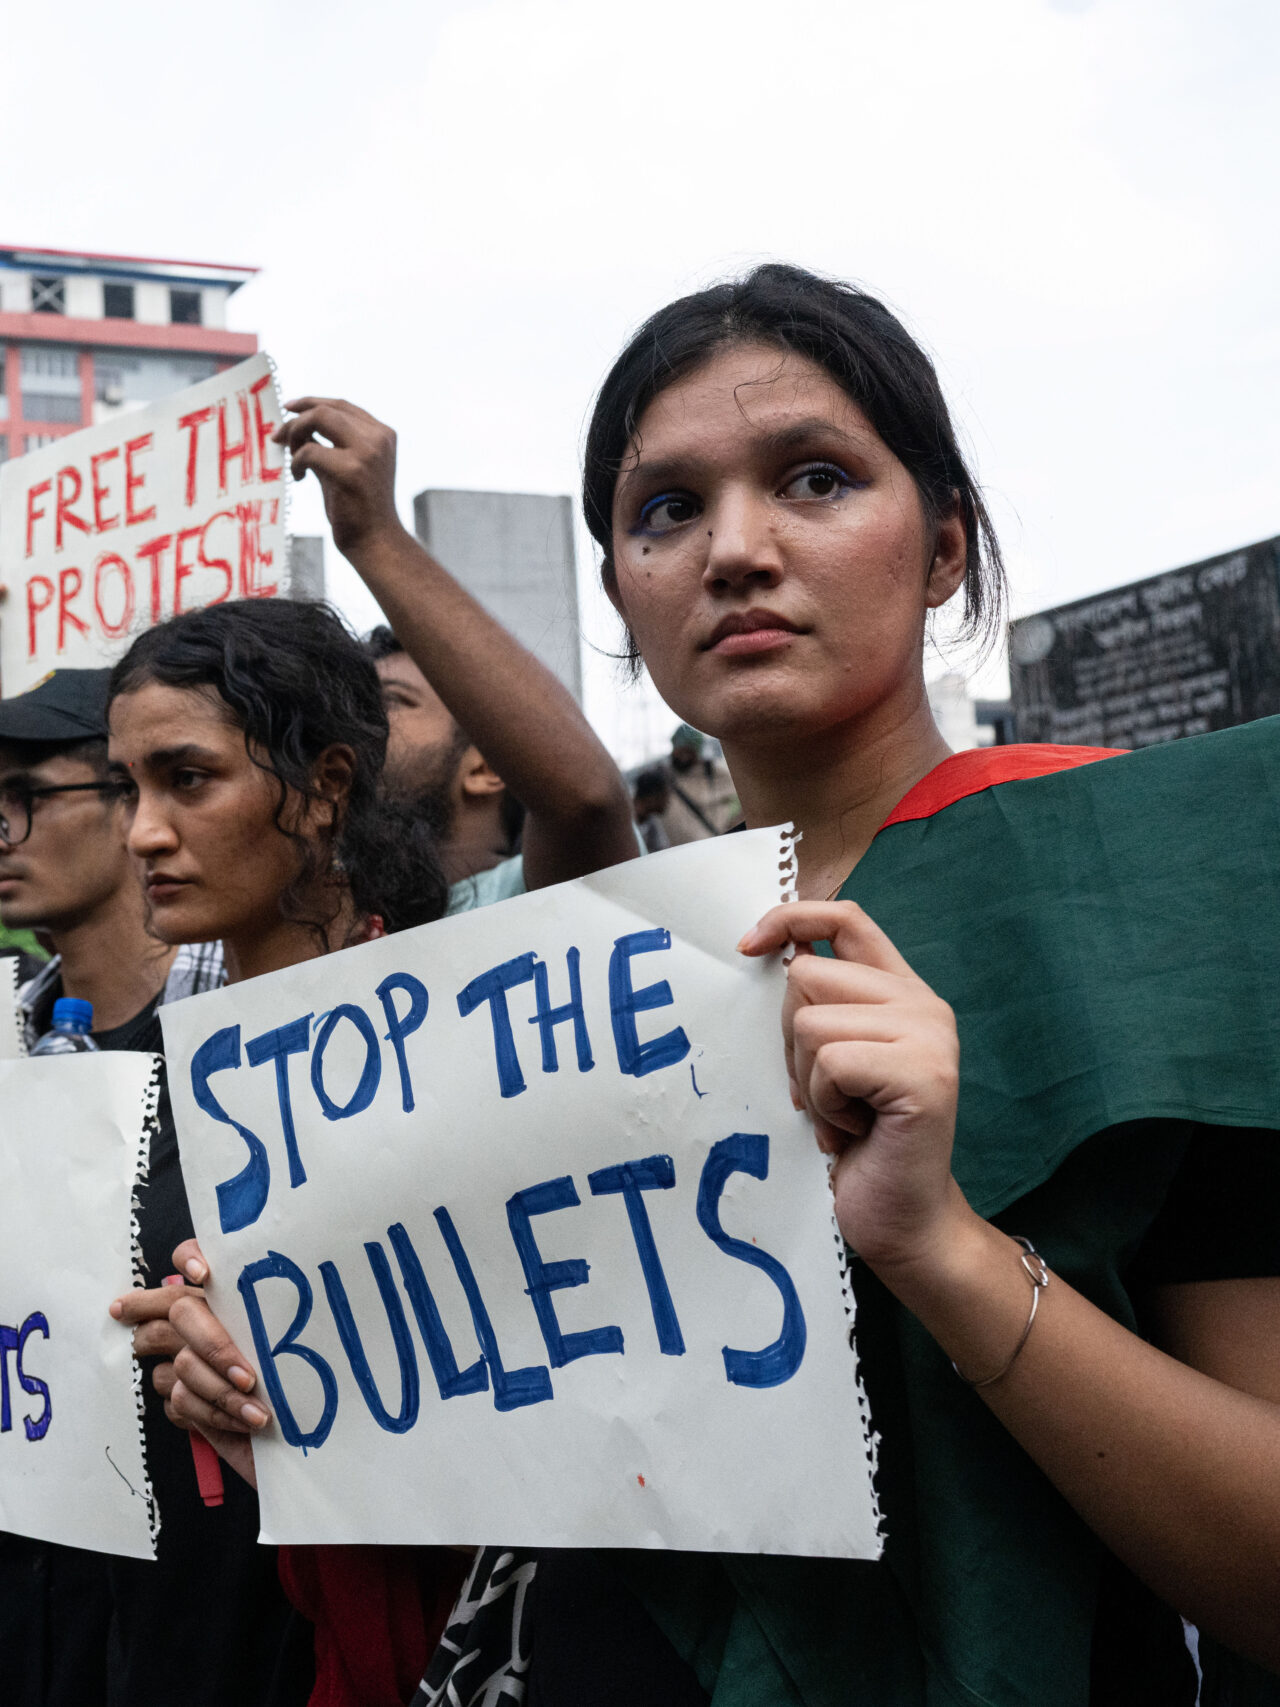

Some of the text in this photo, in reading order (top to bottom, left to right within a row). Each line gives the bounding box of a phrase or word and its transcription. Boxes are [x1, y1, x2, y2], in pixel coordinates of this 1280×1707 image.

[25, 374, 282, 558] FREE THE
[189, 927, 691, 1234] STOP THE
[237, 1132, 808, 1457] BULLETS
